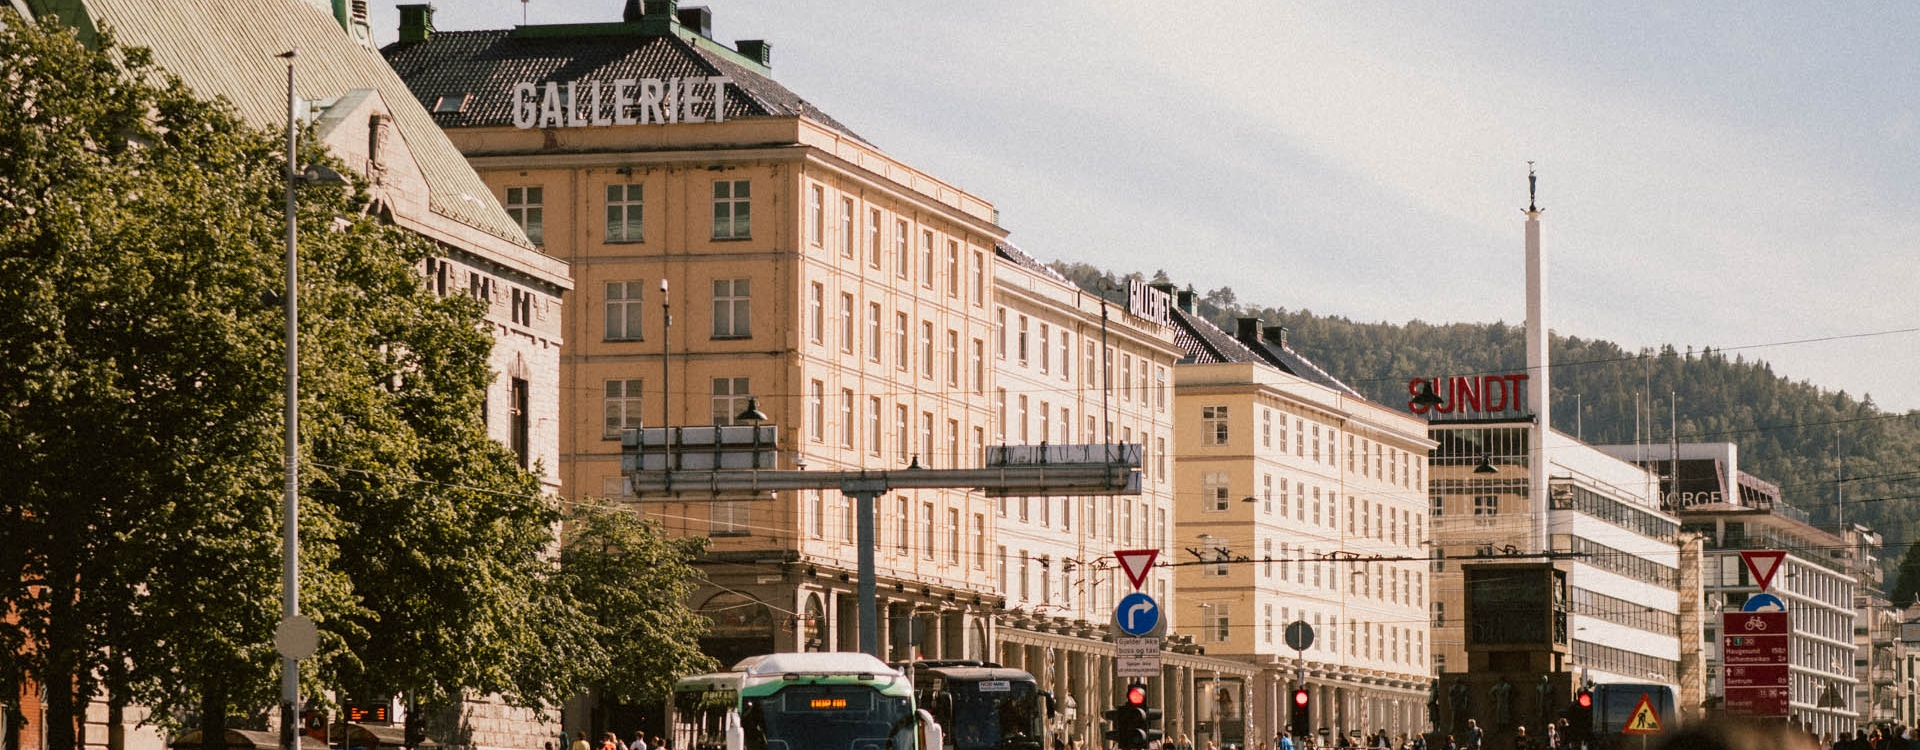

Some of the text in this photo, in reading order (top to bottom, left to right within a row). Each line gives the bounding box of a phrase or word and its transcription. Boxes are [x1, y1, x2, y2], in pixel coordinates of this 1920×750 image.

[513, 76, 734, 130] GALLERIET
[1129, 279, 1171, 328] GALLERIET
[1408, 374, 1530, 415] SUNDT
